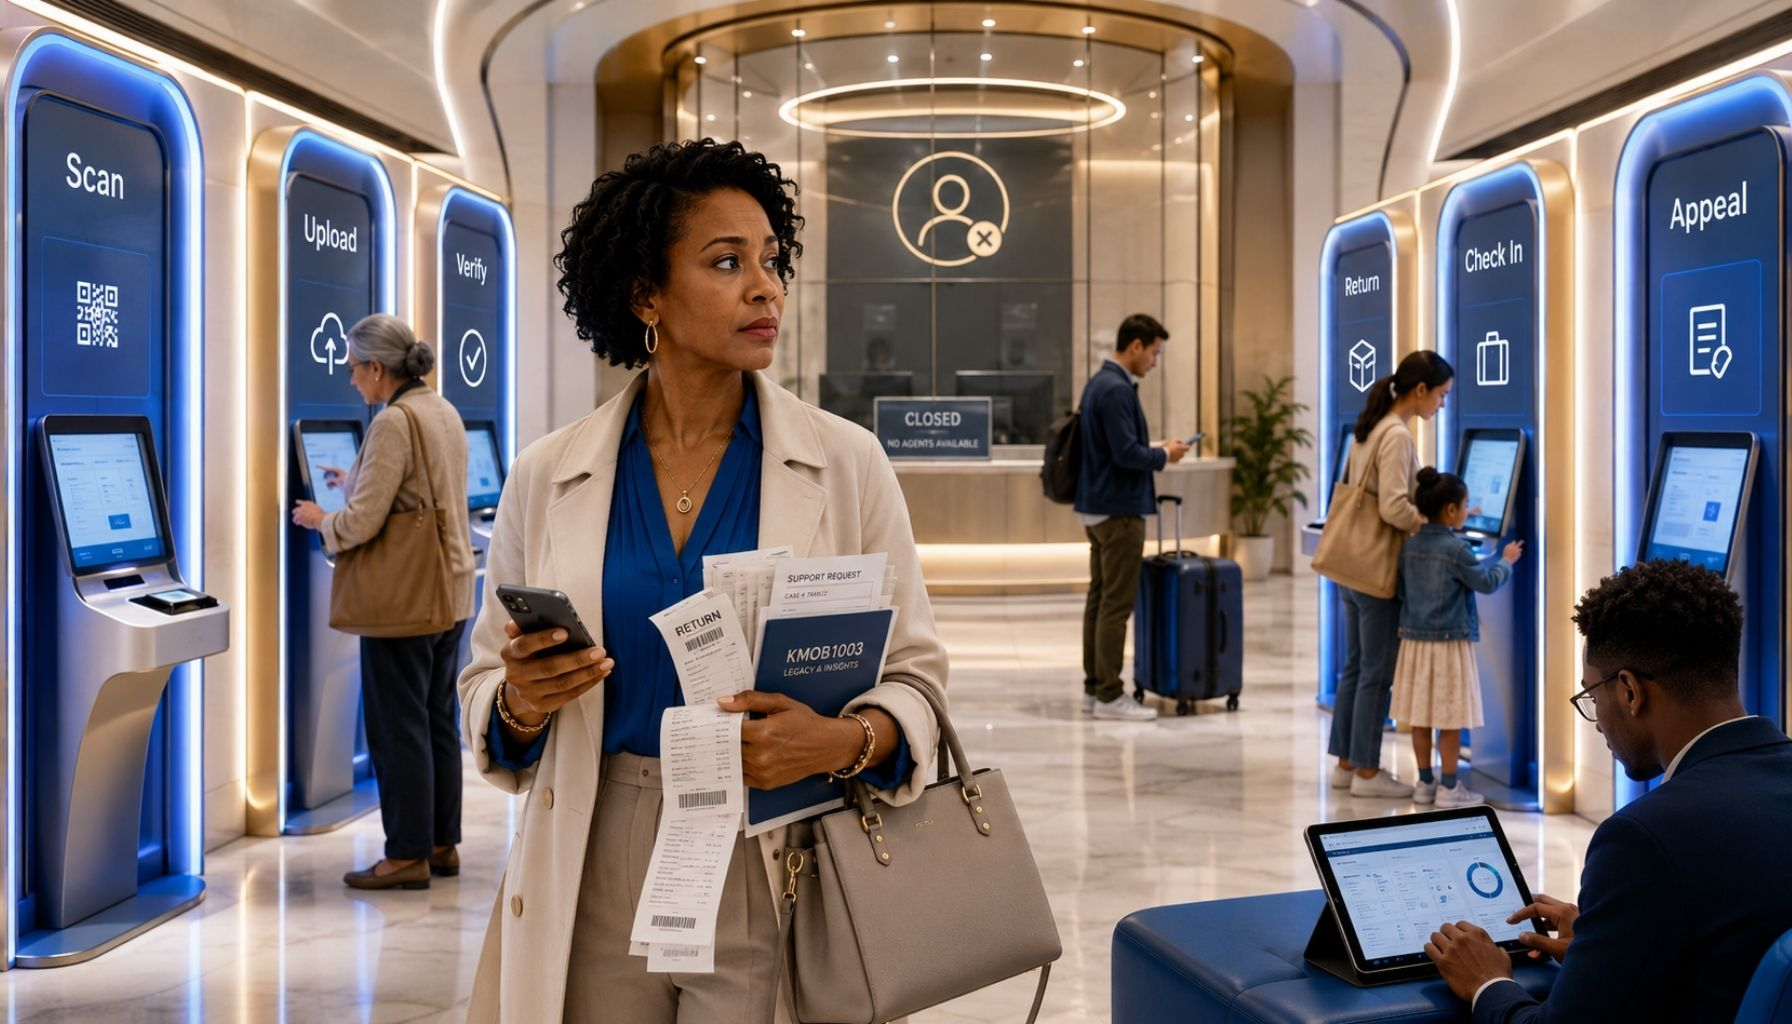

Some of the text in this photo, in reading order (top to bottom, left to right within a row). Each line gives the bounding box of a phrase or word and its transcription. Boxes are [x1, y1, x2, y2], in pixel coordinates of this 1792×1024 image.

[67, 153, 124, 199] Scan
[1670, 180, 1747, 234] Appeal
[305, 214, 357, 253] Upload
[456, 253, 487, 285] Verify
[1465, 240, 1523, 273] Check In
[1345, 275, 1380, 297] Return
[905, 411, 961, 427] CLOSED
[887, 439, 978, 449] NO AGENTS AVAILABLE
[787, 570, 862, 583] SUPPORT REQUEST
[674, 609, 722, 637] RETURN
[786, 642, 864, 663] KMOB1003
[783, 666, 815, 677] LEGACY
